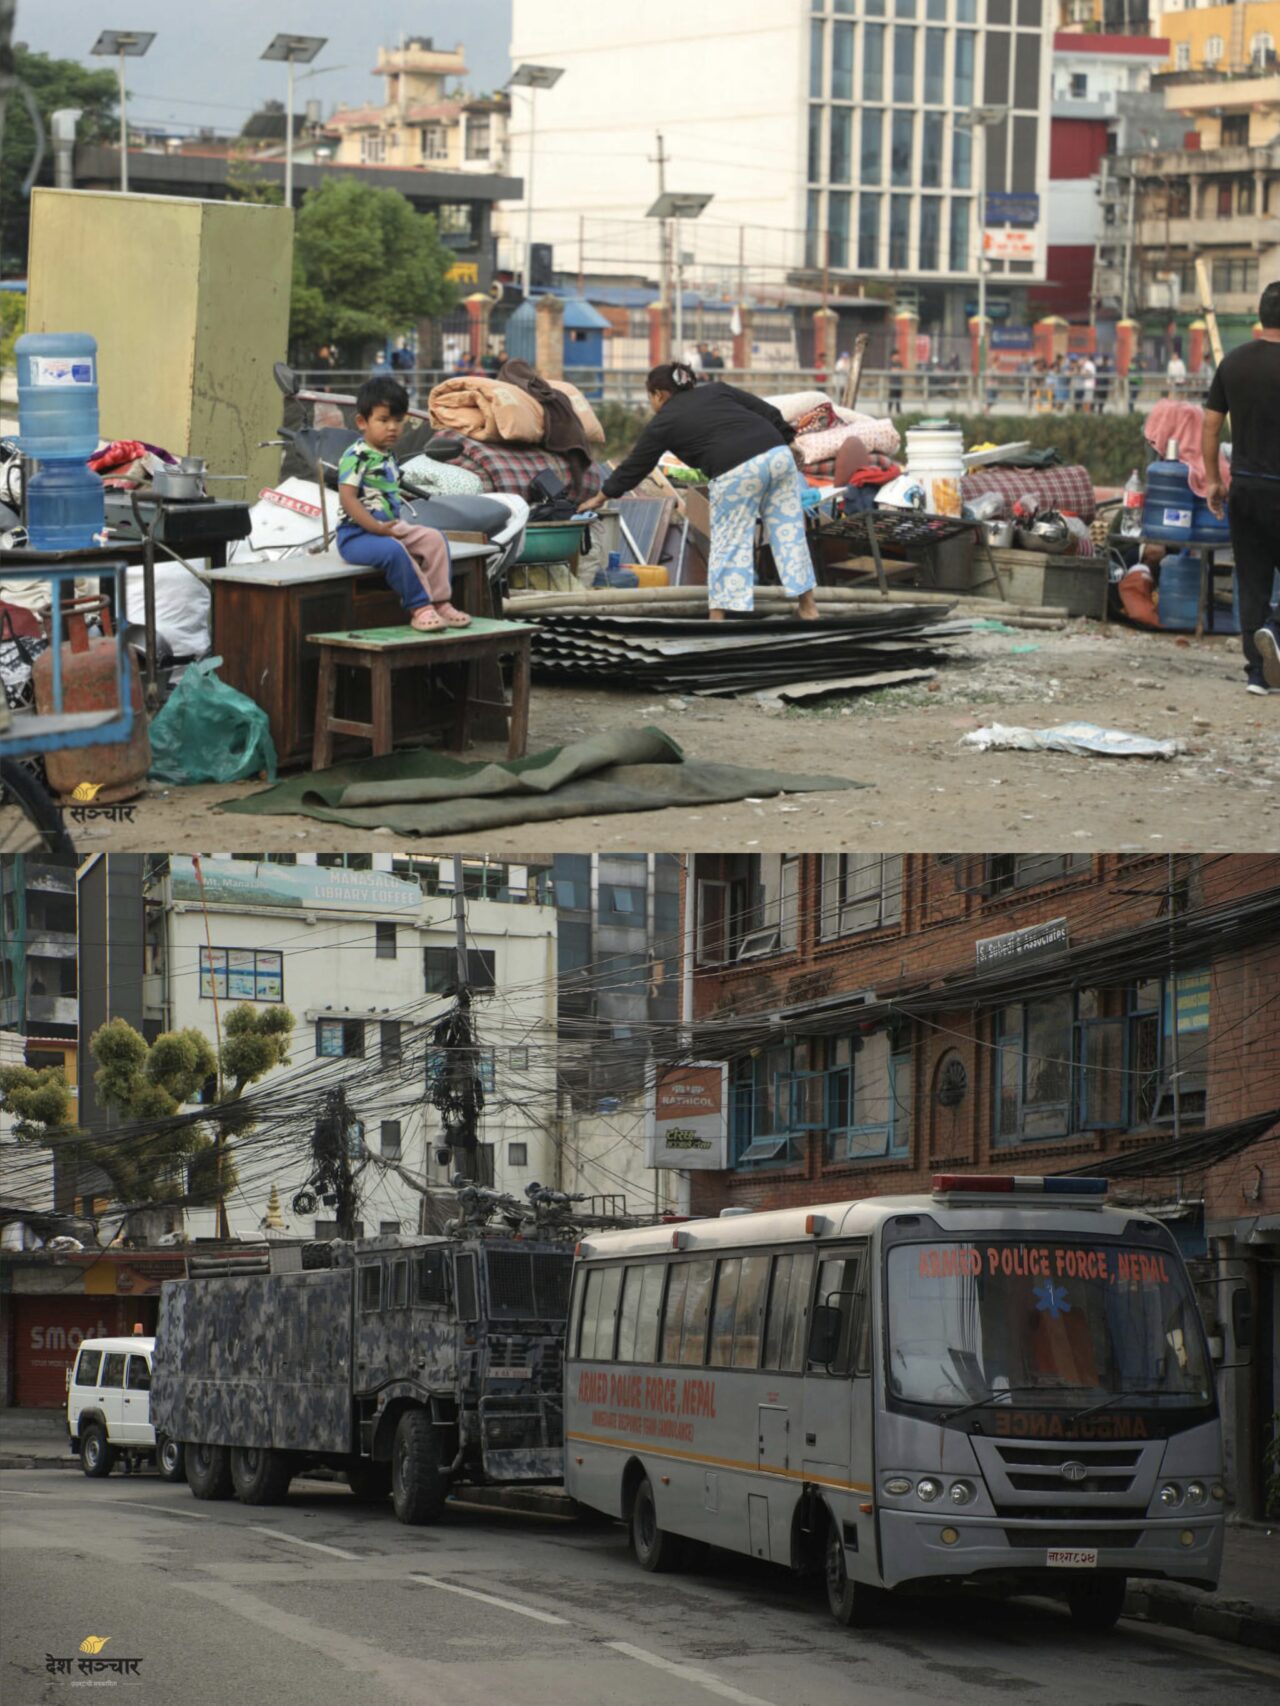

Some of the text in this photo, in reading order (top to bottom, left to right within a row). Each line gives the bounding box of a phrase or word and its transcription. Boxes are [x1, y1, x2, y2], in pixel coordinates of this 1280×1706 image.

[315, 885, 416, 904] LIBRARY COFFEE
[920, 1248, 982, 1279] ARMED
[987, 1248, 1051, 1276] POLICE
[1117, 1253, 1169, 1283] NEPAL
[578, 1371, 608, 1405] ARMED
[610, 1373, 642, 1409] POLICE
[682, 1379, 717, 1419] NEPAL
